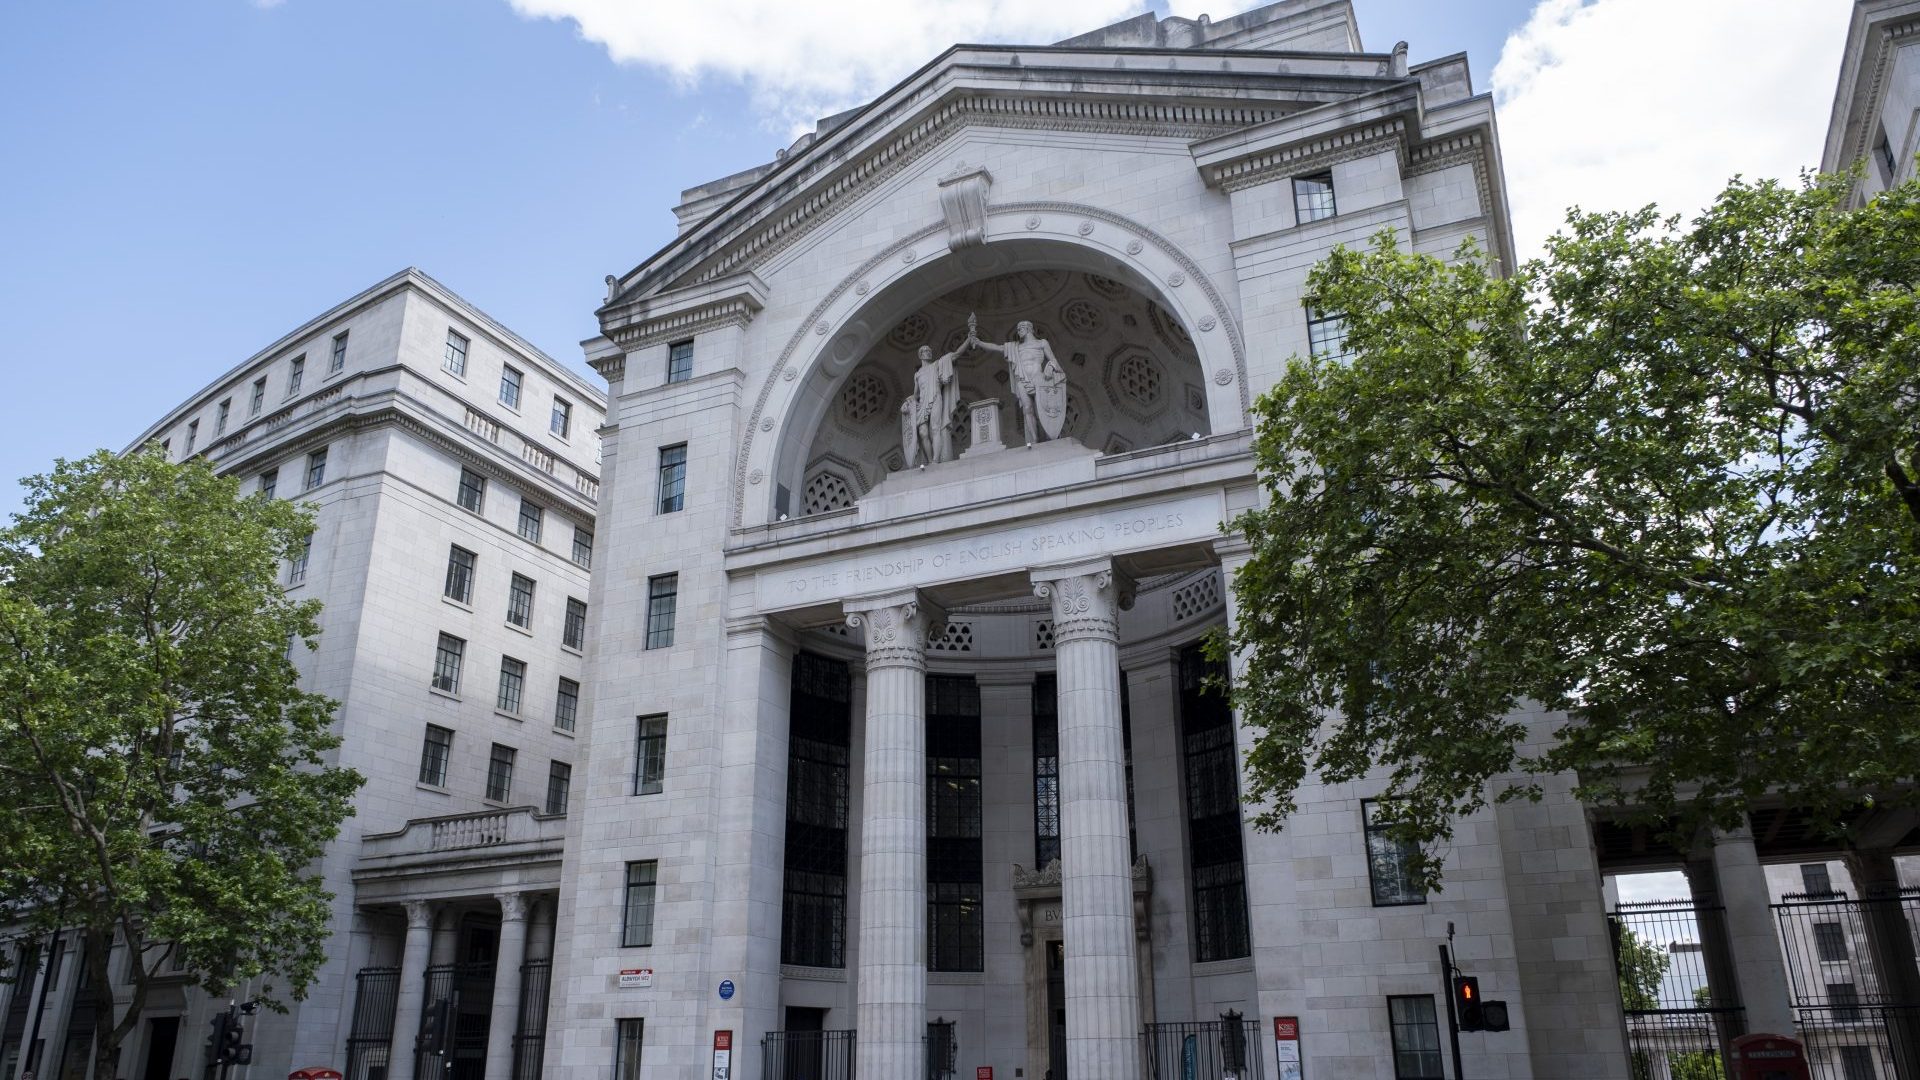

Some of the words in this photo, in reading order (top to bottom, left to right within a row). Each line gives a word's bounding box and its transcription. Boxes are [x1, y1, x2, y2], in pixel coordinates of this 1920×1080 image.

[785, 579, 807, 592] TO
[812, 573, 838, 590] THE
[846, 558, 924, 584] FRIENDSHIP
[933, 552, 951, 568] OF
[959, 540, 1022, 565] ENGLISH
[1031, 526, 1106, 552] SPEAKING
[1114, 513, 1184, 537] PEOPLES
